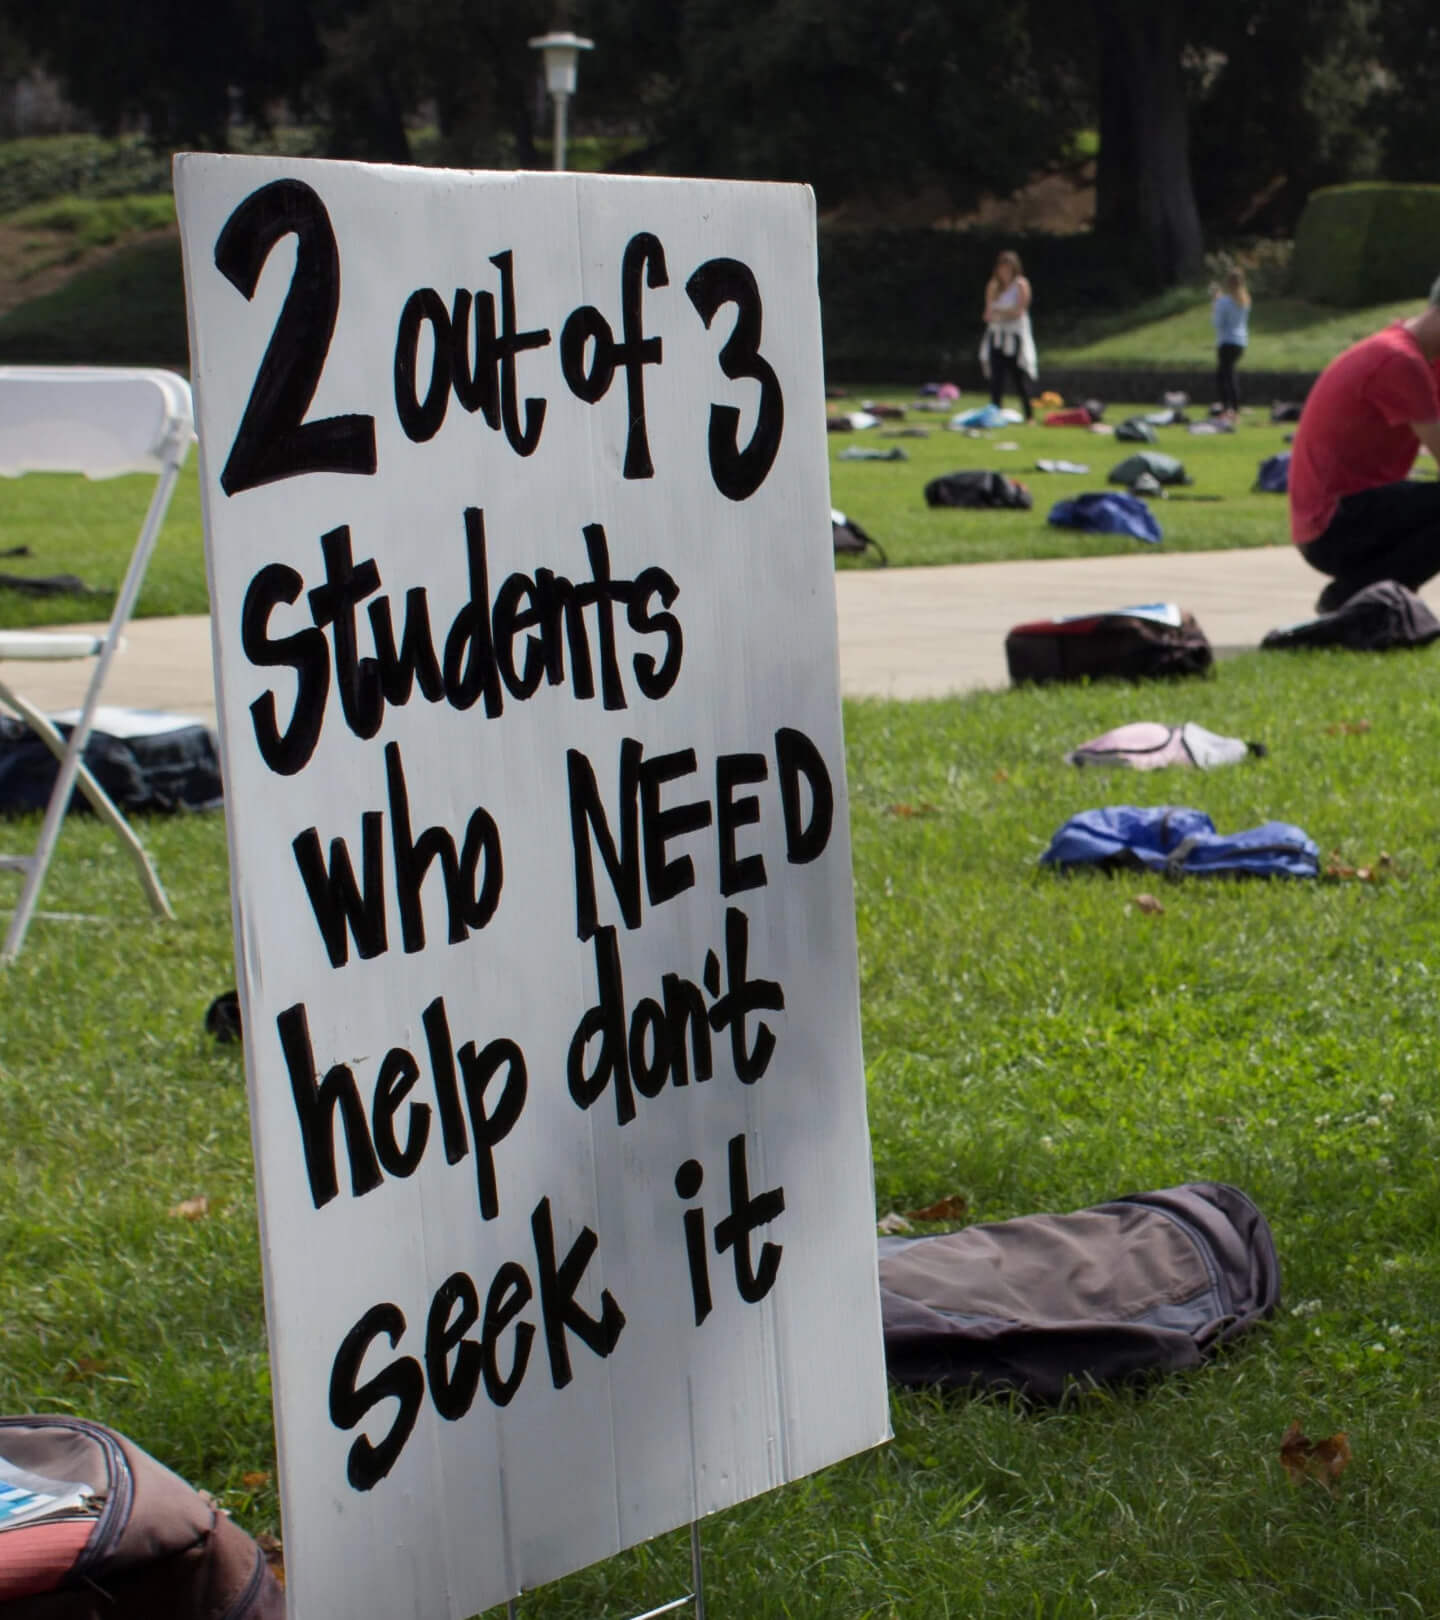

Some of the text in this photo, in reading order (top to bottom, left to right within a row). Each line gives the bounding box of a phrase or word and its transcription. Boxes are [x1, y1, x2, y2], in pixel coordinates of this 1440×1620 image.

[214, 178, 784, 502] 2 out of 3
[292, 727, 834, 969] who NEED
[276, 906, 785, 1222] help don't
[674, 1133, 786, 1327] it
